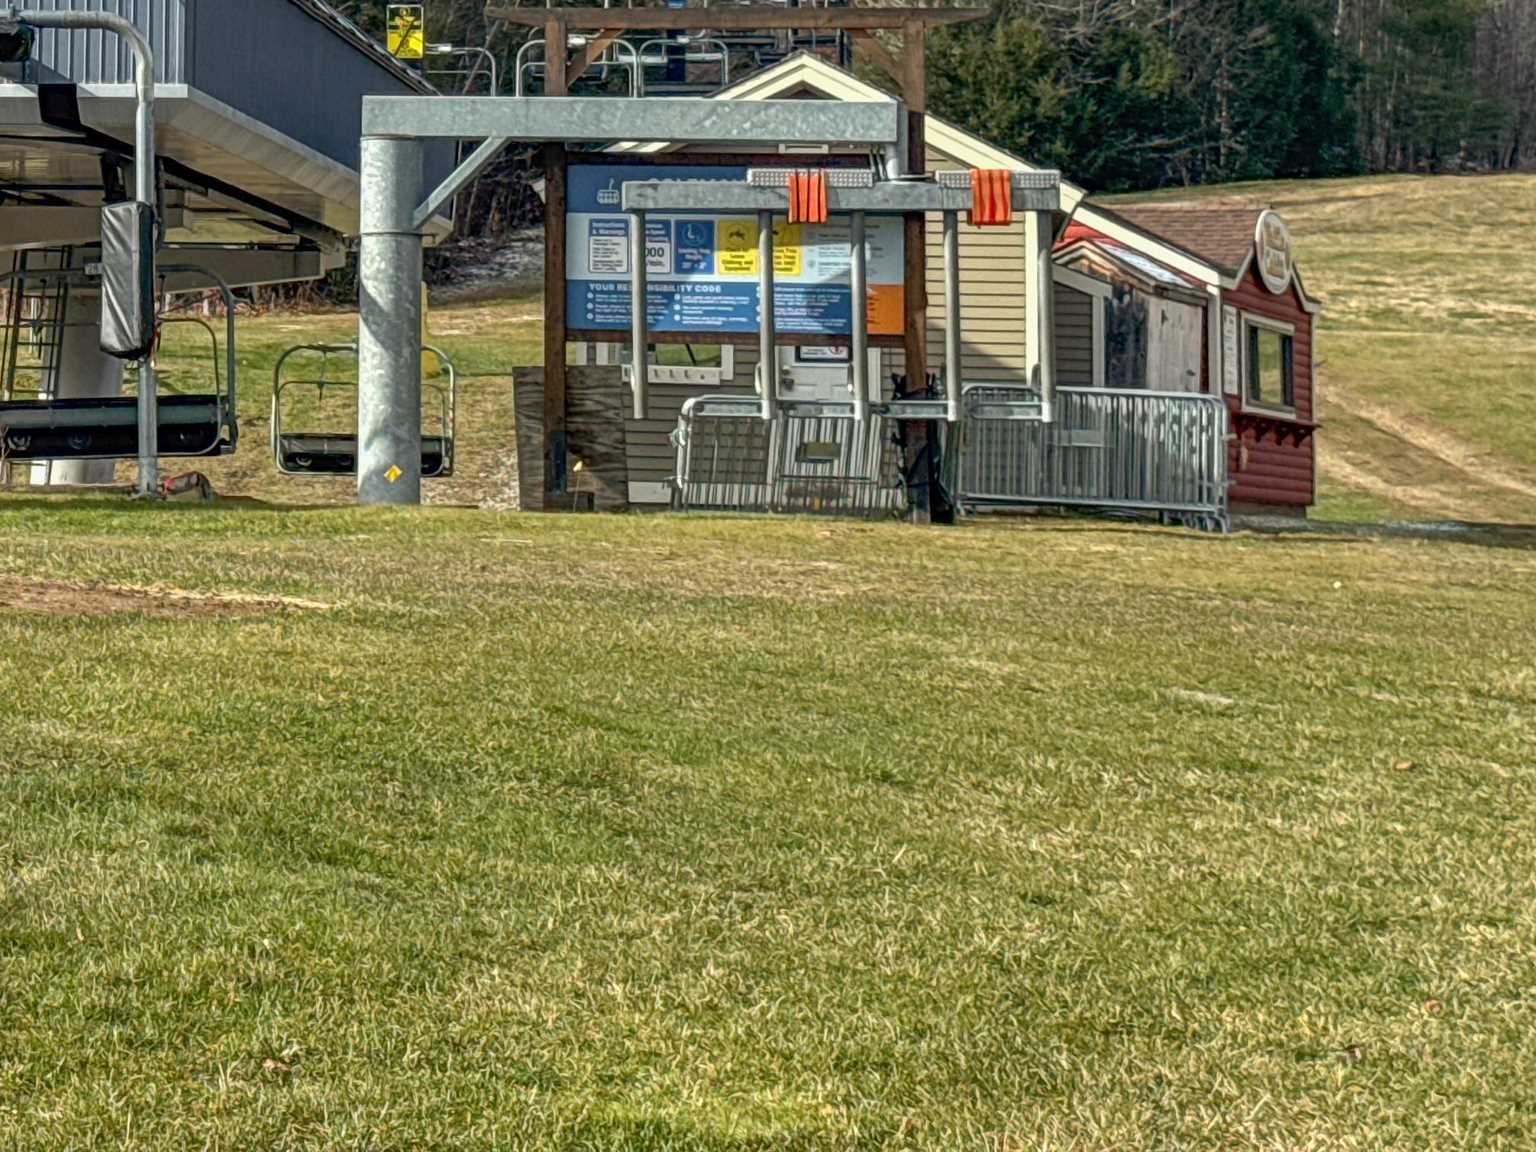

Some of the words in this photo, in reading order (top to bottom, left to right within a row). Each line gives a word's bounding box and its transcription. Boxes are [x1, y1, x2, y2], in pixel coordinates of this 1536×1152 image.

[644, 247, 665, 258] 000
[589, 283, 615, 291] YOUR
[616, 283, 693, 293] RESNSIBILITY
[694, 284, 722, 293] CODE
